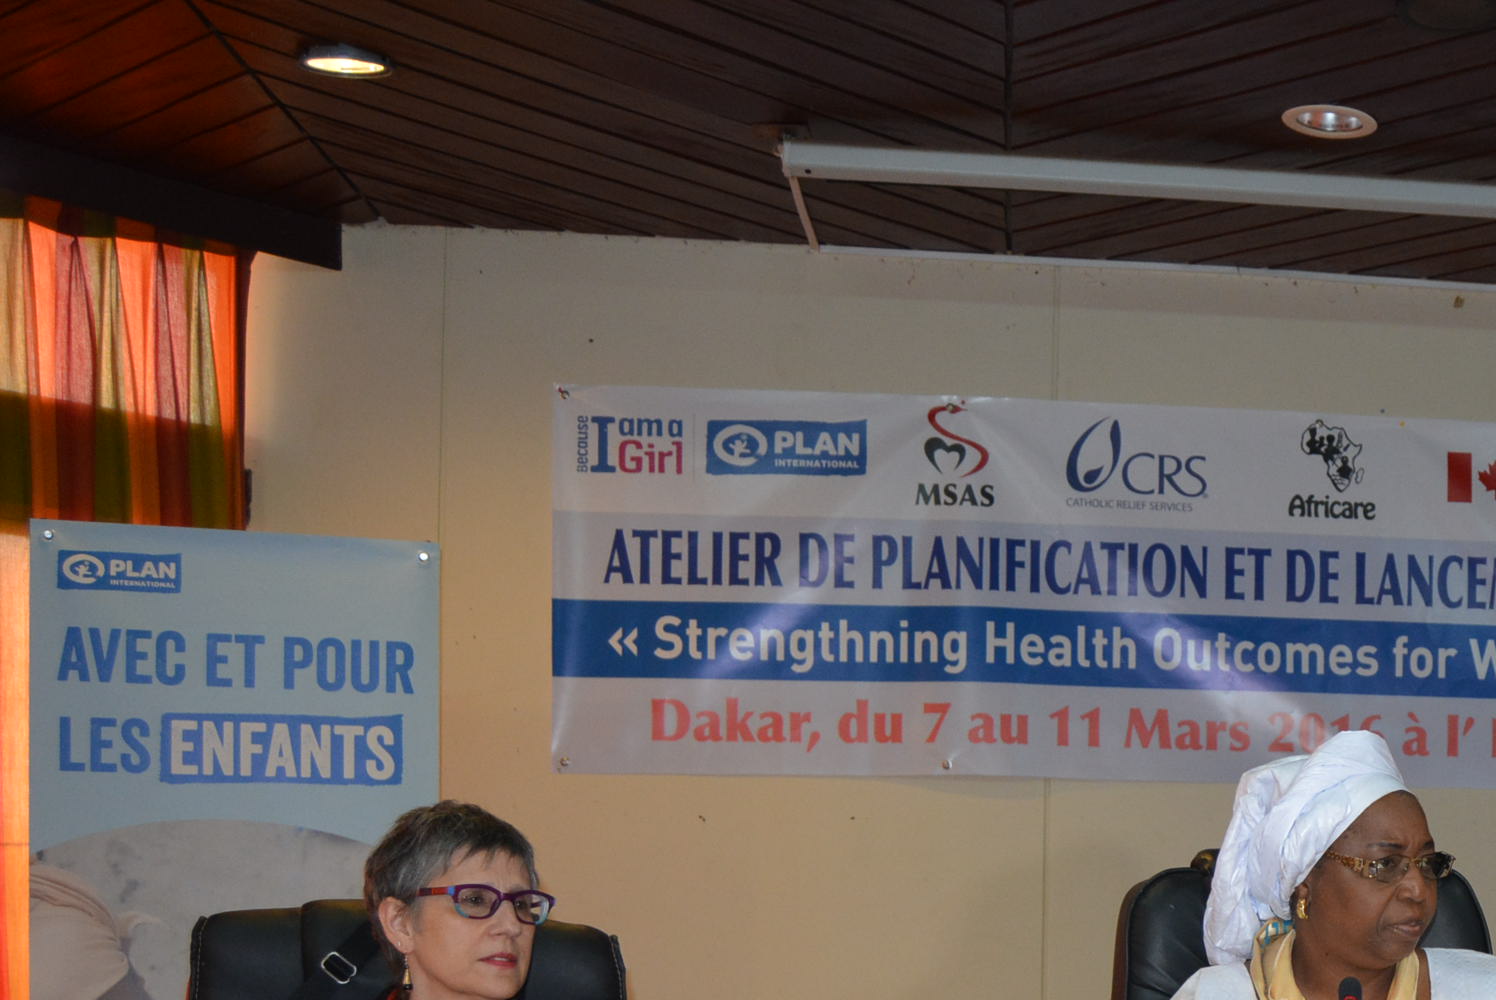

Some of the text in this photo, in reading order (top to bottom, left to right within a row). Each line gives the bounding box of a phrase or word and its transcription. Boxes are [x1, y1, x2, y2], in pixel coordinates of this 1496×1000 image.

[590, 416, 617, 474] I
[618, 439, 683, 475] Girl
[774, 430, 860, 457] PLAN
[774, 459, 860, 469] INTERNATIONAL
[1122, 452, 1207, 497] CRS
[915, 483, 995, 507] MSAS
[1065, 497, 1193, 513] CATHOLIC RELIEF SERVICES
[1288, 494, 1376, 521] Africare
[109, 557, 176, 579] PLAN
[110, 579, 175, 588] INTERNATIONAL
[603, 528, 783, 587] ATELIER
[799, 532, 855, 589] DE
[871, 534, 1208, 599] PLANIFICATION
[1224, 546, 1272, 601] ET
[1285, 549, 1340, 604] DE
[57, 626, 415, 695] AVEC ET POUR
[653, 614, 968, 675] Strengthning
[985, 620, 1136, 669] Health
[1153, 627, 1378, 674] Outcomes
[1393, 635, 1458, 679] for
[650, 697, 821, 753] Dakar,
[837, 699, 903, 745] du
[922, 702, 952, 744] 7
[967, 712, 1029, 745] au
[1049, 705, 1100, 748] 11
[1124, 707, 1251, 752] Mars
[1402, 712, 1429, 758] à
[59, 716, 396, 781] LES ENFANTS
